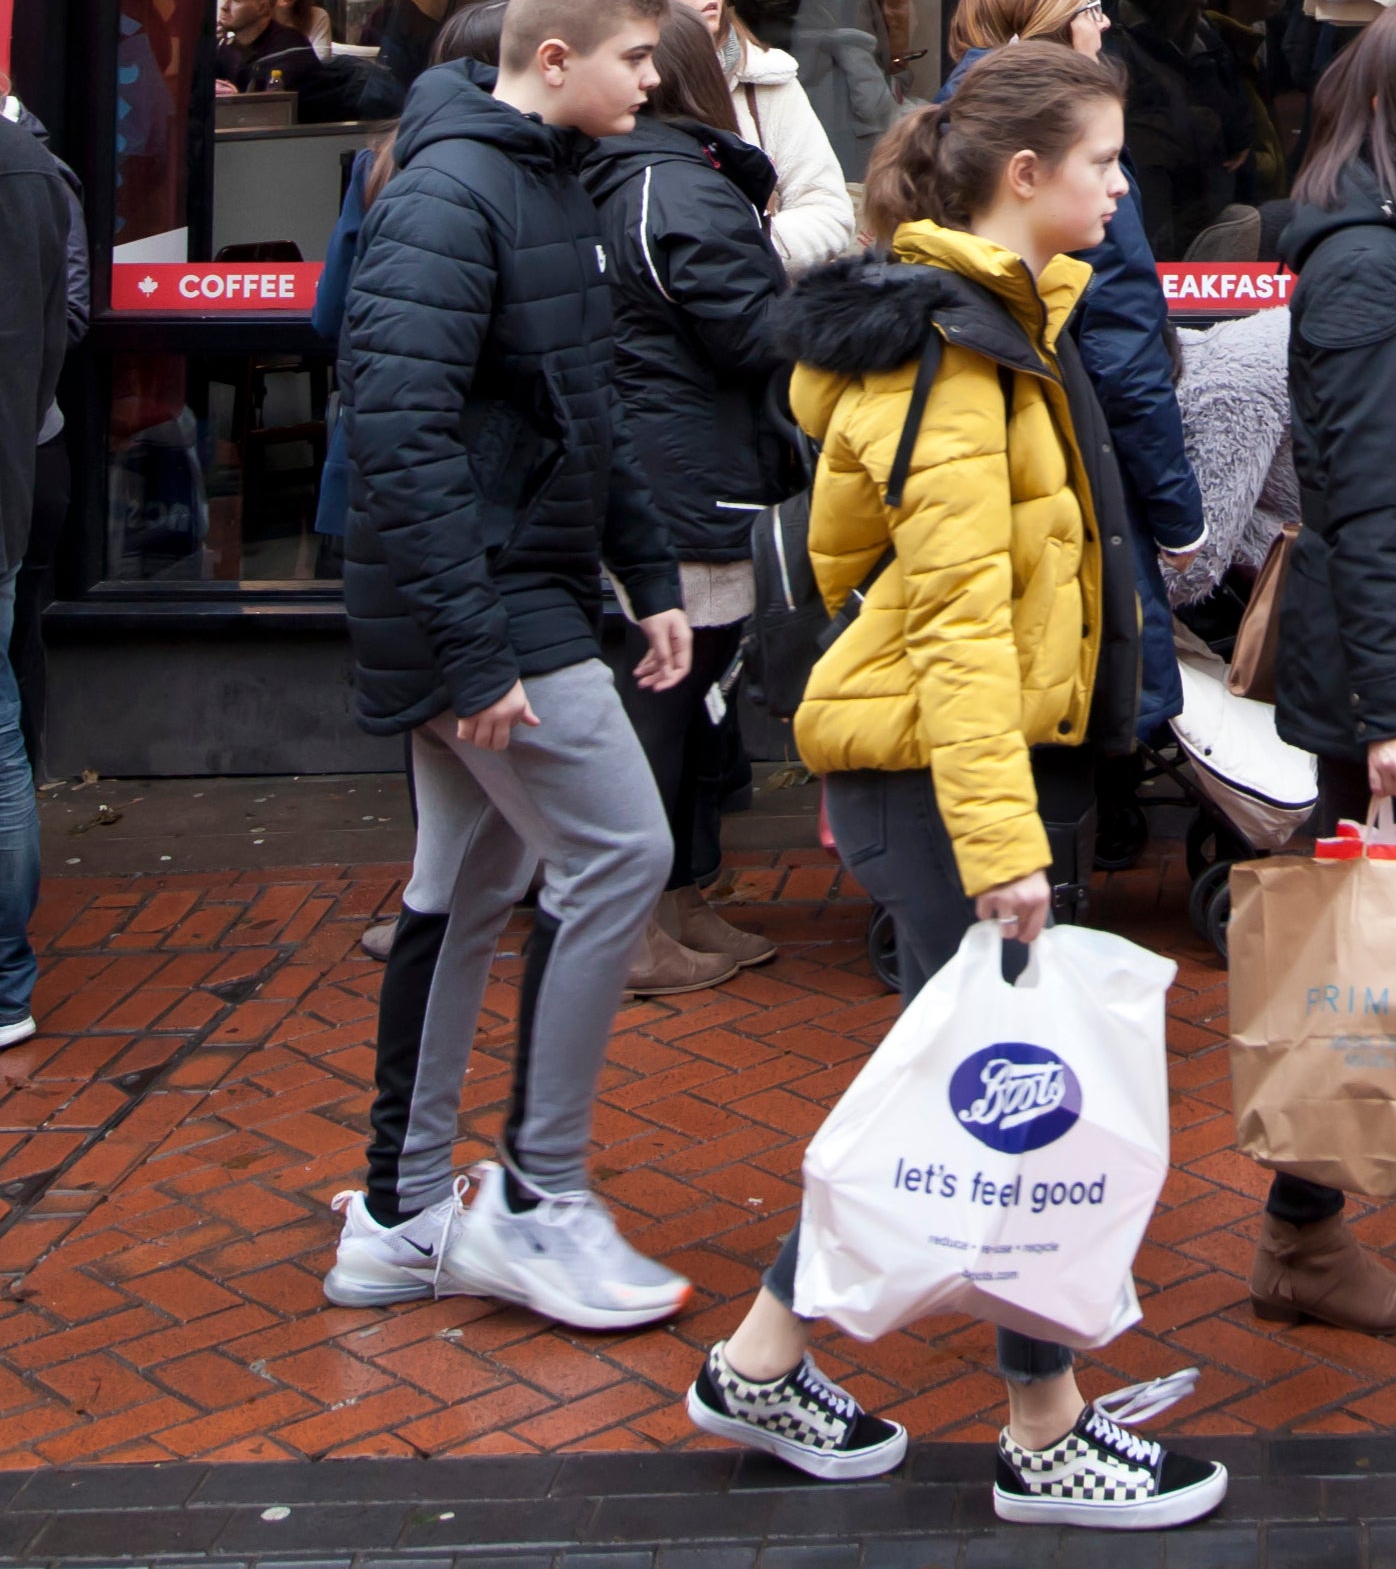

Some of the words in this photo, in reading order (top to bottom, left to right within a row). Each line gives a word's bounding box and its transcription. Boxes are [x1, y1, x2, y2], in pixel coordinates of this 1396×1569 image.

[180, 275, 294, 297] COFFEE
[1163, 275, 1291, 298] EAKFAST
[958, 1058, 1067, 1130] Boots
[971, 1171, 1022, 1207] feel
[1031, 1173, 1107, 1213] good
